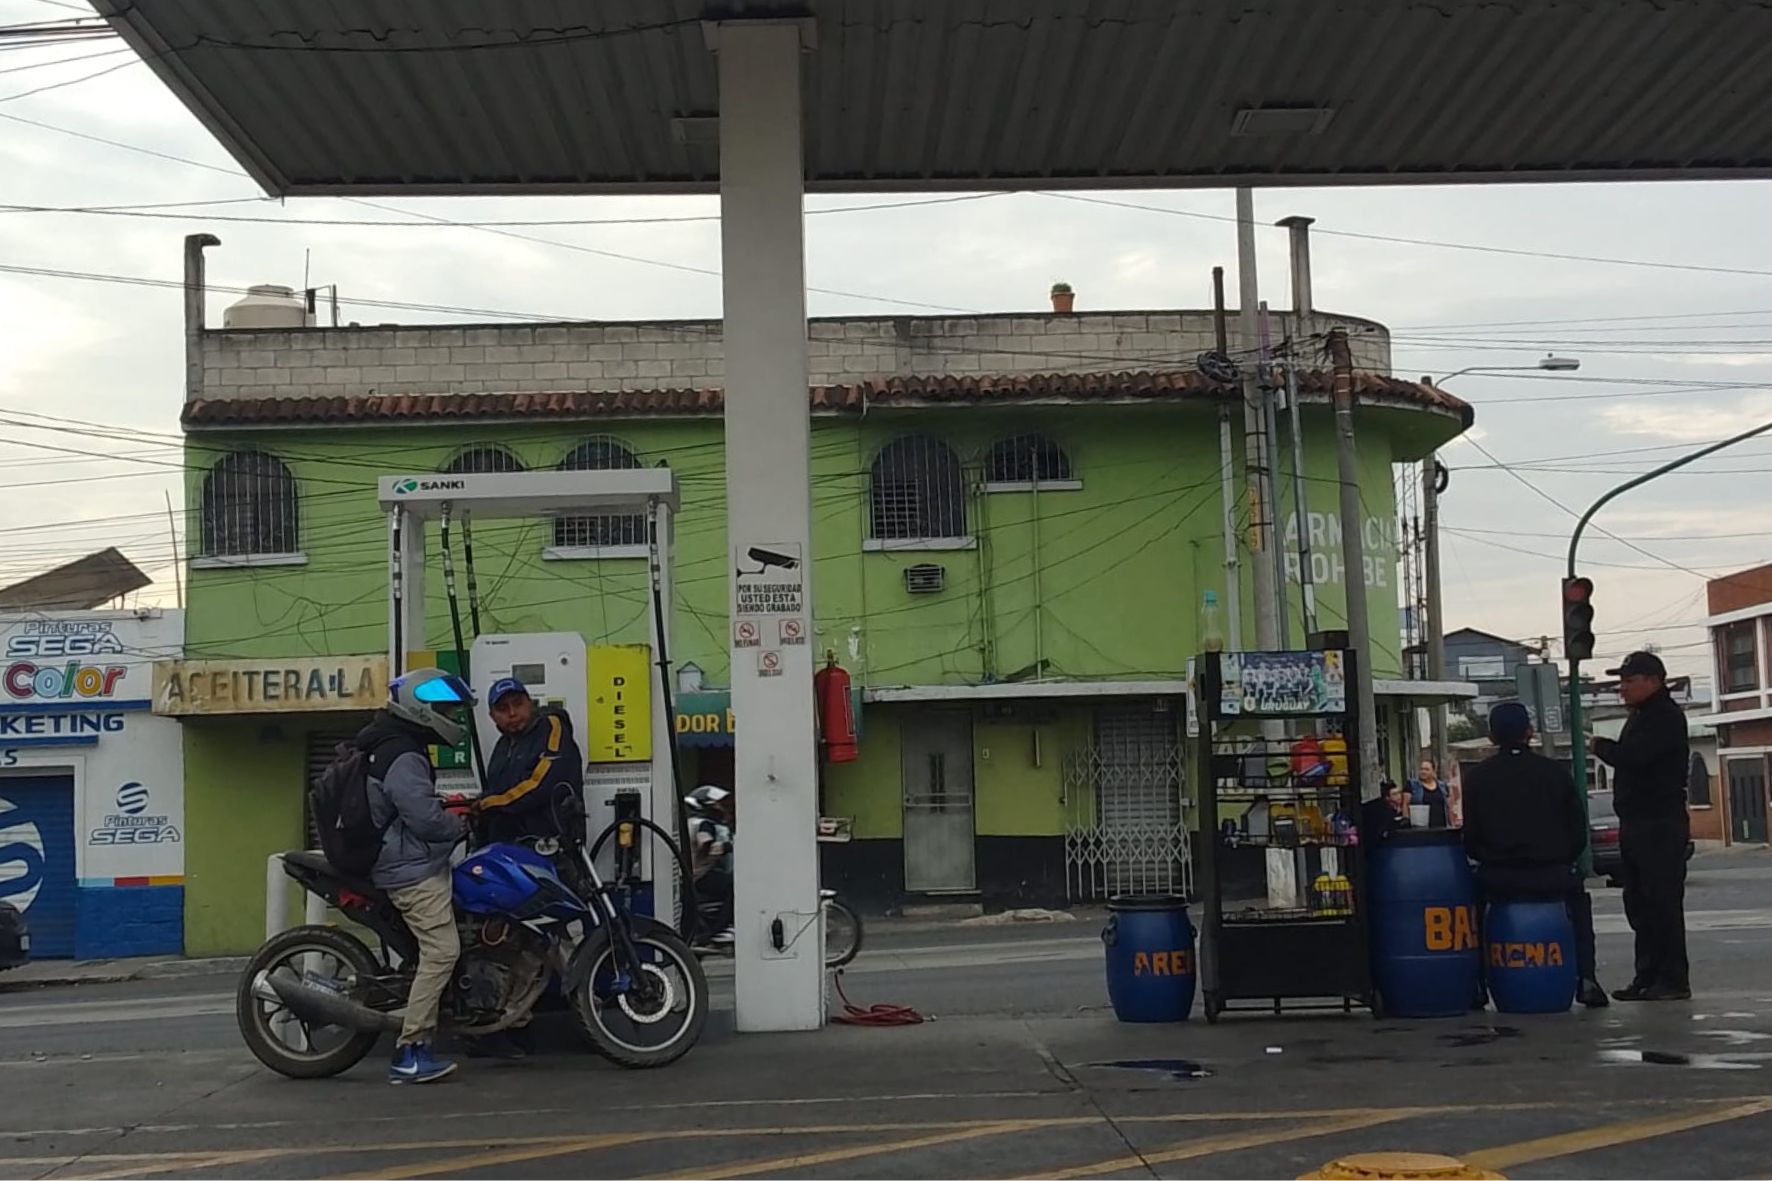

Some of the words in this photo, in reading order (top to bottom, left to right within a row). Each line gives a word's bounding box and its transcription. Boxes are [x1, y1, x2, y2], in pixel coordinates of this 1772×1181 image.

[420, 481, 466, 490] SANKI
[738, 584, 751, 593] POR
[753, 584, 762, 593] SU
[763, 584, 802, 593] SEGURIDAD
[740, 594, 771, 603] USTED
[773, 593, 797, 603] ESTA
[737, 603, 765, 613] SIENDO
[766, 603, 801, 613] GRABADO
[24, 620, 112, 634] Pinturas
[6, 632, 123, 658] SEGA
[3, 660, 128, 699] Color
[336, 667, 375, 699] LA
[1260, 700, 1310, 710] URUGUAY
[0, 713, 125, 735] KETING
[613, 677, 626, 758] DIESEL
[676, 714, 720, 733] DOR
[0, 750, 18, 766] S
[104, 815, 168, 827] Pinturas
[88, 826, 181, 846] SEGA
[1424, 906, 1478, 951] BA
[1134, 951, 1190, 977] ARE
